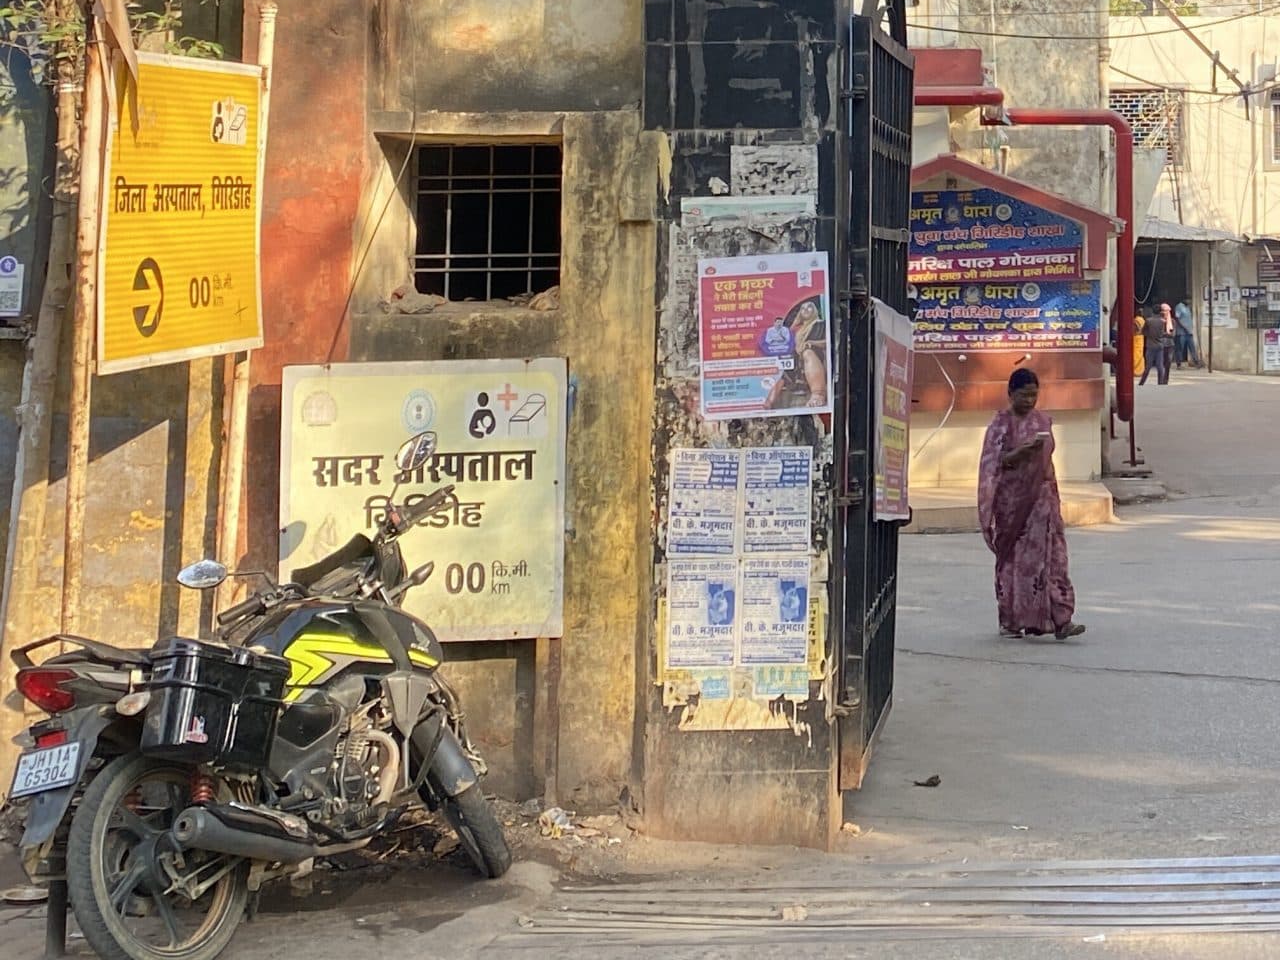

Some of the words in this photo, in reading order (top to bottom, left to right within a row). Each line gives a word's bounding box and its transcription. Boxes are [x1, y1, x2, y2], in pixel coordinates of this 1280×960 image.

[114, 176, 148, 213] जिला
[153, 183, 206, 219] अस्पताल,
[211, 176, 252, 210] गिरिडीह
[910, 208, 942, 224] अमृत
[964, 205, 992, 218] धारा
[970, 224, 1026, 240] गिरिडीह
[1028, 224, 1064, 237] शाखा
[958, 256, 996, 269] पाल
[999, 252, 1076, 266] गोयनका
[189, 276, 210, 308] 00
[713, 280, 737, 292] एक
[920, 286, 960, 305] अमृत
[984, 285, 1018, 299] धारा
[951, 306, 1002, 319] गिरिडीह
[1004, 307, 1041, 318] शाखा
[312, 455, 384, 487] सदर
[700, 521, 732, 532] मजूमदार
[774, 519, 806, 531] मजूमदार
[491, 560, 531, 578] कि.मी.
[445, 562, 485, 594] 00
[491, 581, 511, 594] km
[700, 626, 732, 638] मजूमदार
[772, 623, 804, 635] मजूमदार
[28, 748, 71, 771] JH11A
[24, 766, 68, 786] G5304
